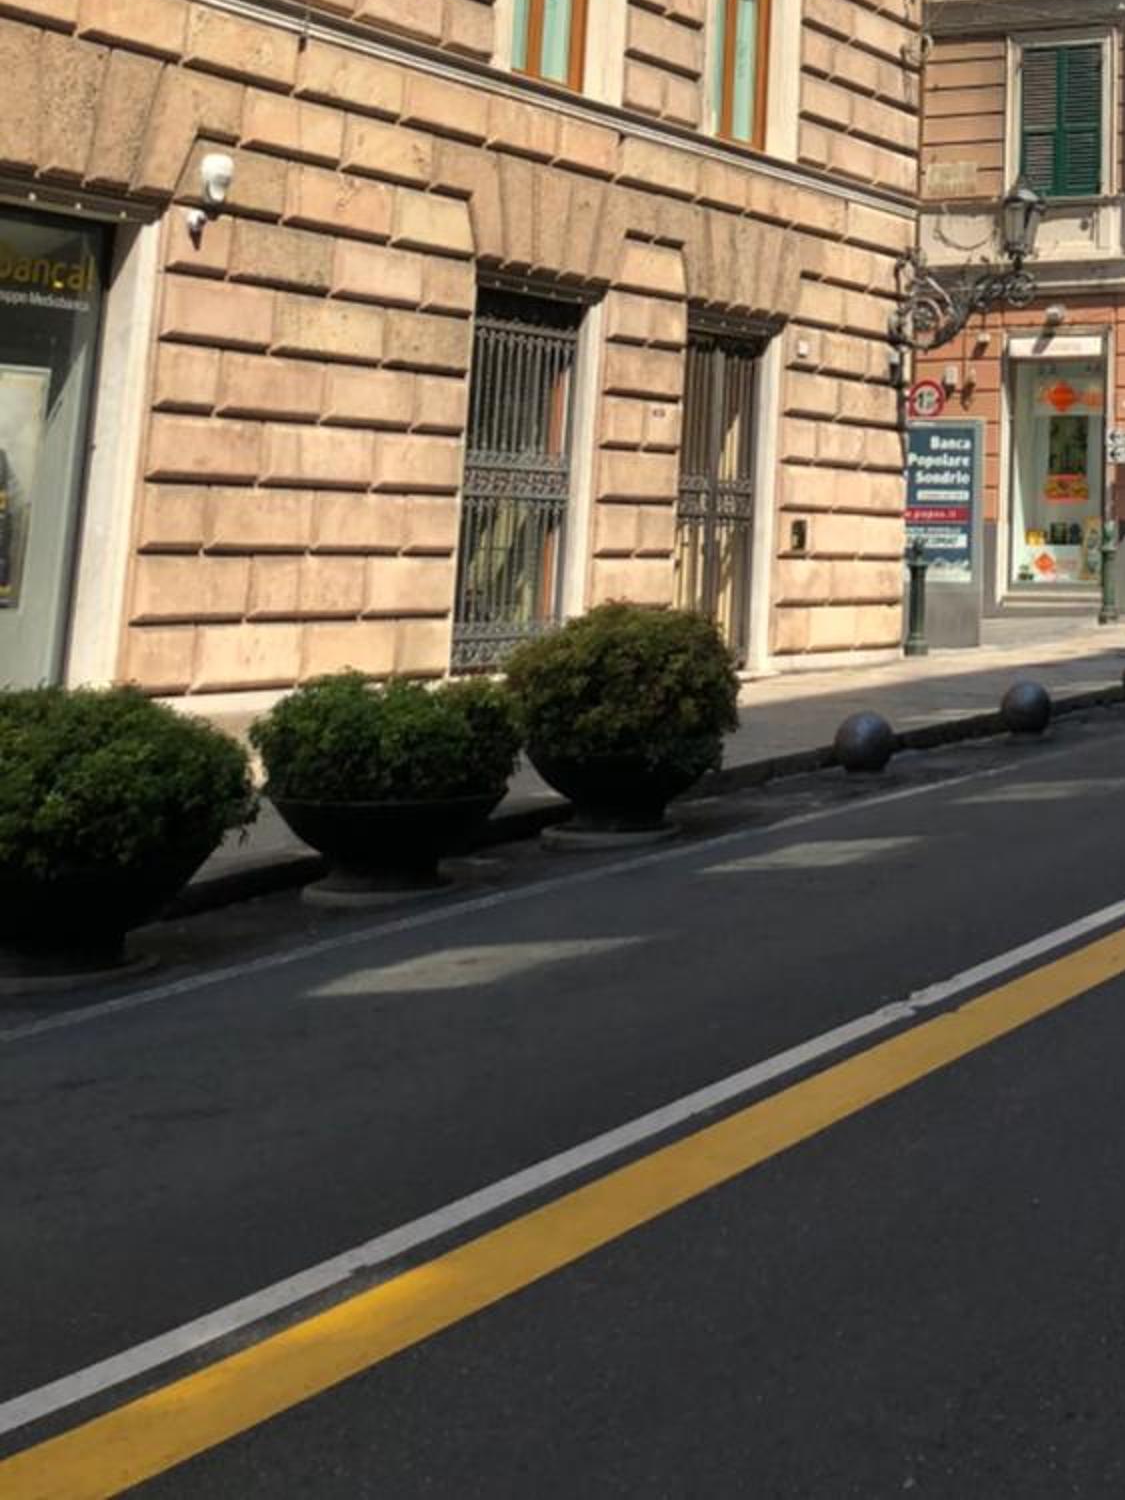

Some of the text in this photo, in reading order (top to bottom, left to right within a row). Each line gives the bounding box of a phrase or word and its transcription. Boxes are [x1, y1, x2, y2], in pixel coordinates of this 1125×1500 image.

[29, 291, 89, 311] Mediobanca
[930, 435, 972, 450] Banca
[907, 453, 970, 470] Popolare
[915, 470, 970, 485] Sondrio
